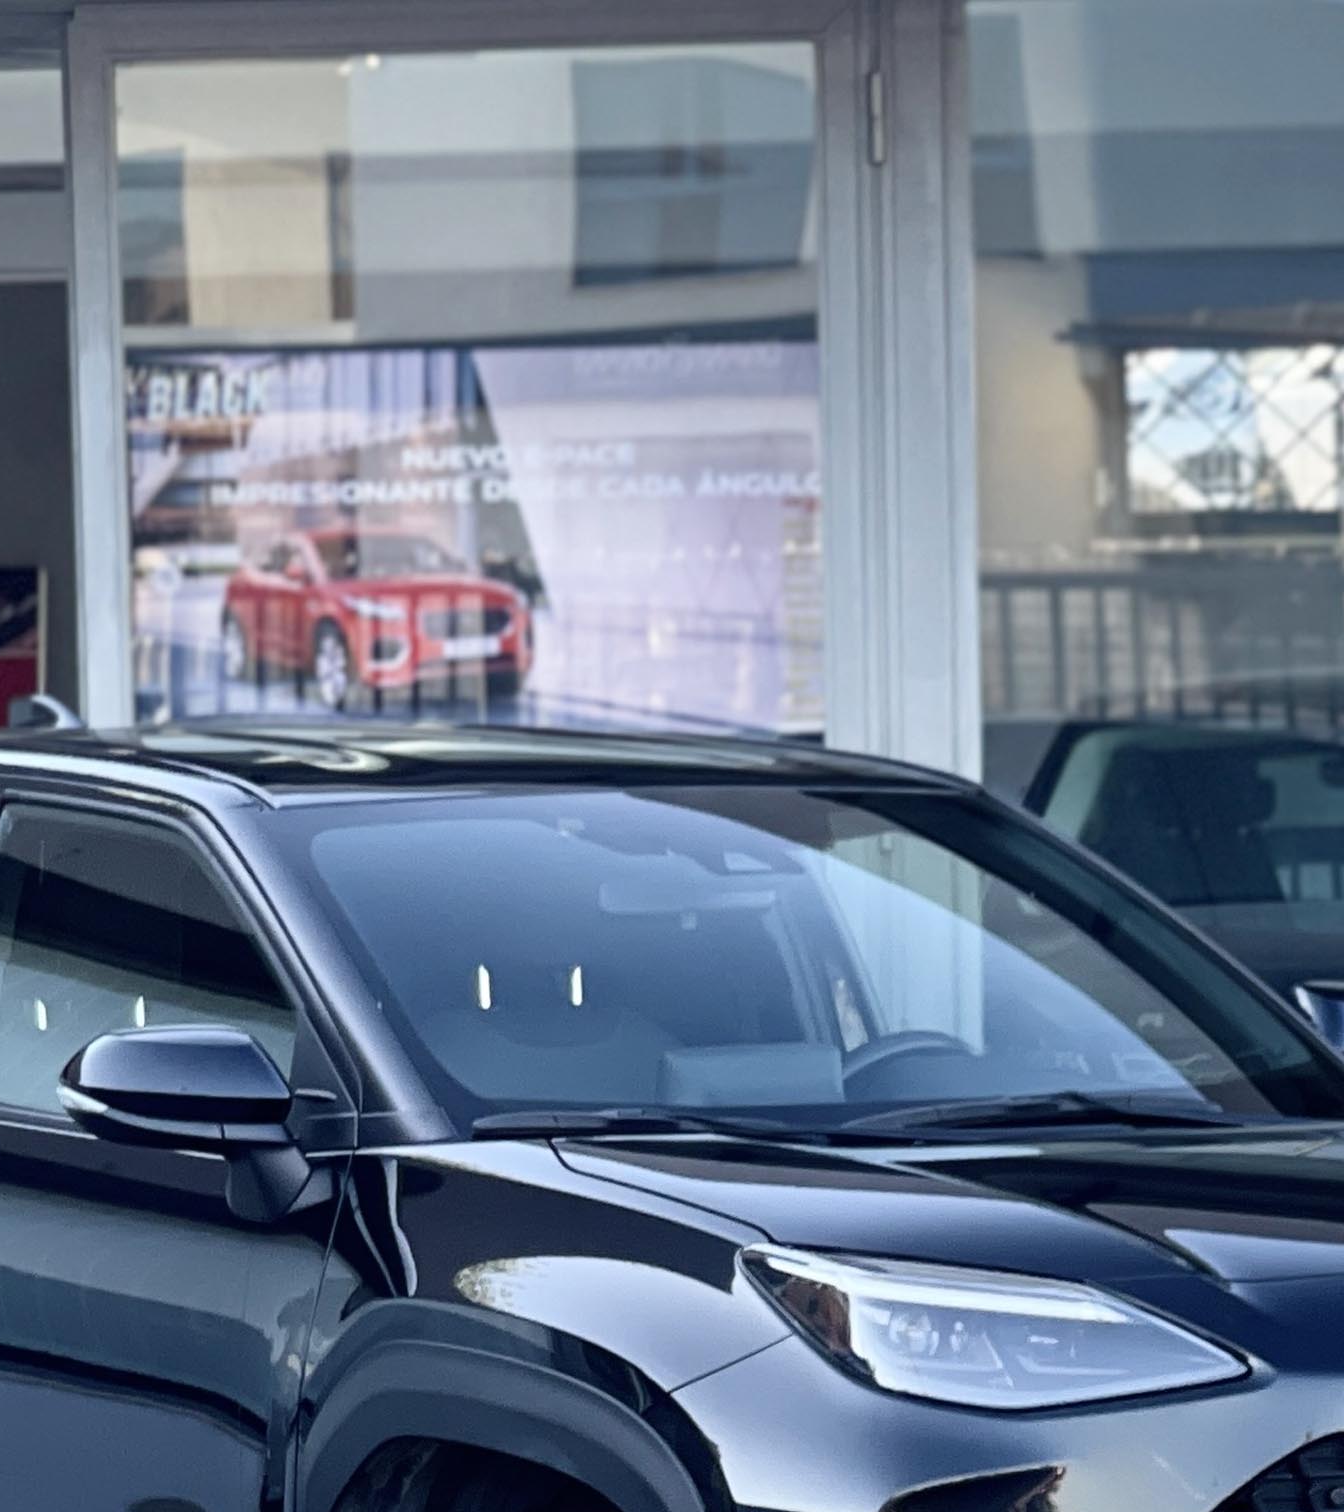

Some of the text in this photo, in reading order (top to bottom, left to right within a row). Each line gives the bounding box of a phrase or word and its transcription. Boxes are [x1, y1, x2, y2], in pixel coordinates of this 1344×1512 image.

[146, 368, 271, 421] BLACK
[482, 477, 586, 500] DDE
[598, 472, 685, 498] CADA
